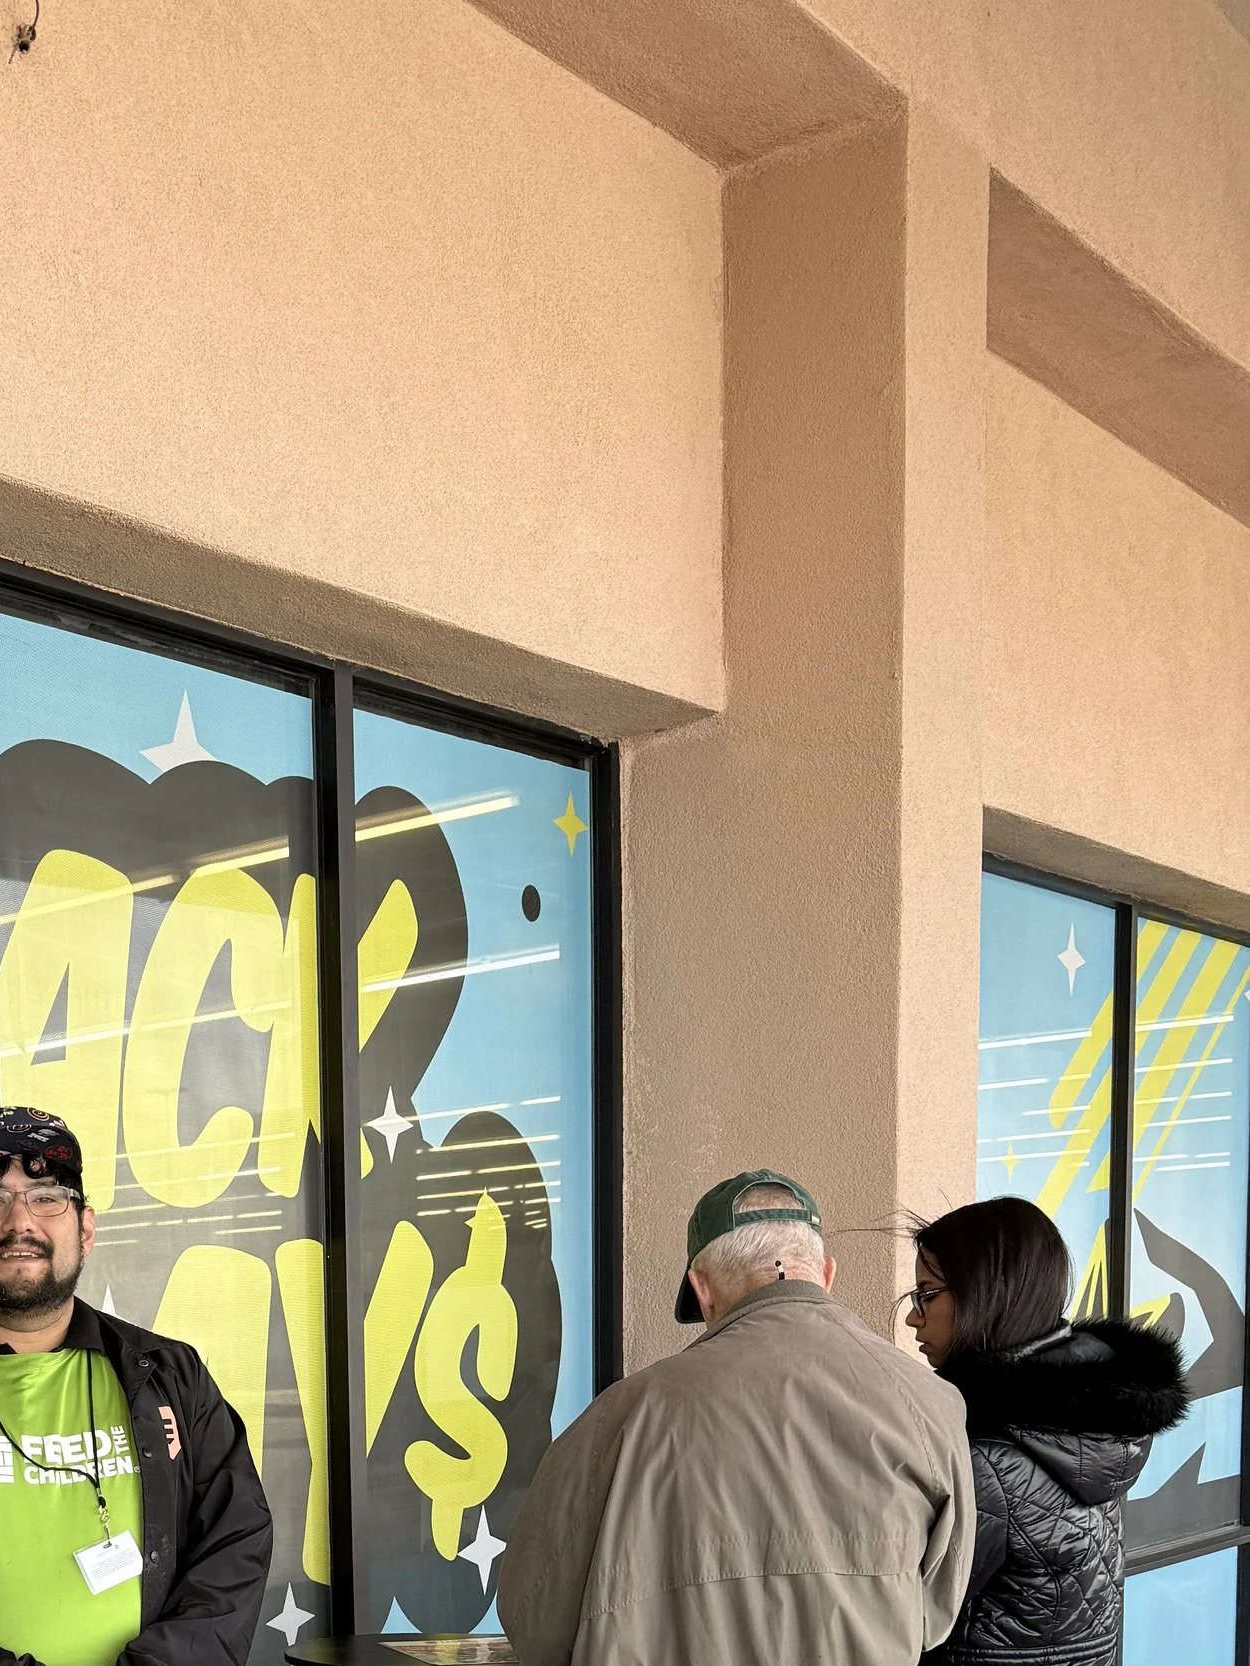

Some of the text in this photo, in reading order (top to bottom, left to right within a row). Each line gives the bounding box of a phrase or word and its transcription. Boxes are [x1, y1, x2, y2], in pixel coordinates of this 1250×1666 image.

[21, 1425, 129, 1465] FEED THE
[23, 1455, 134, 1485] CHILDREN
